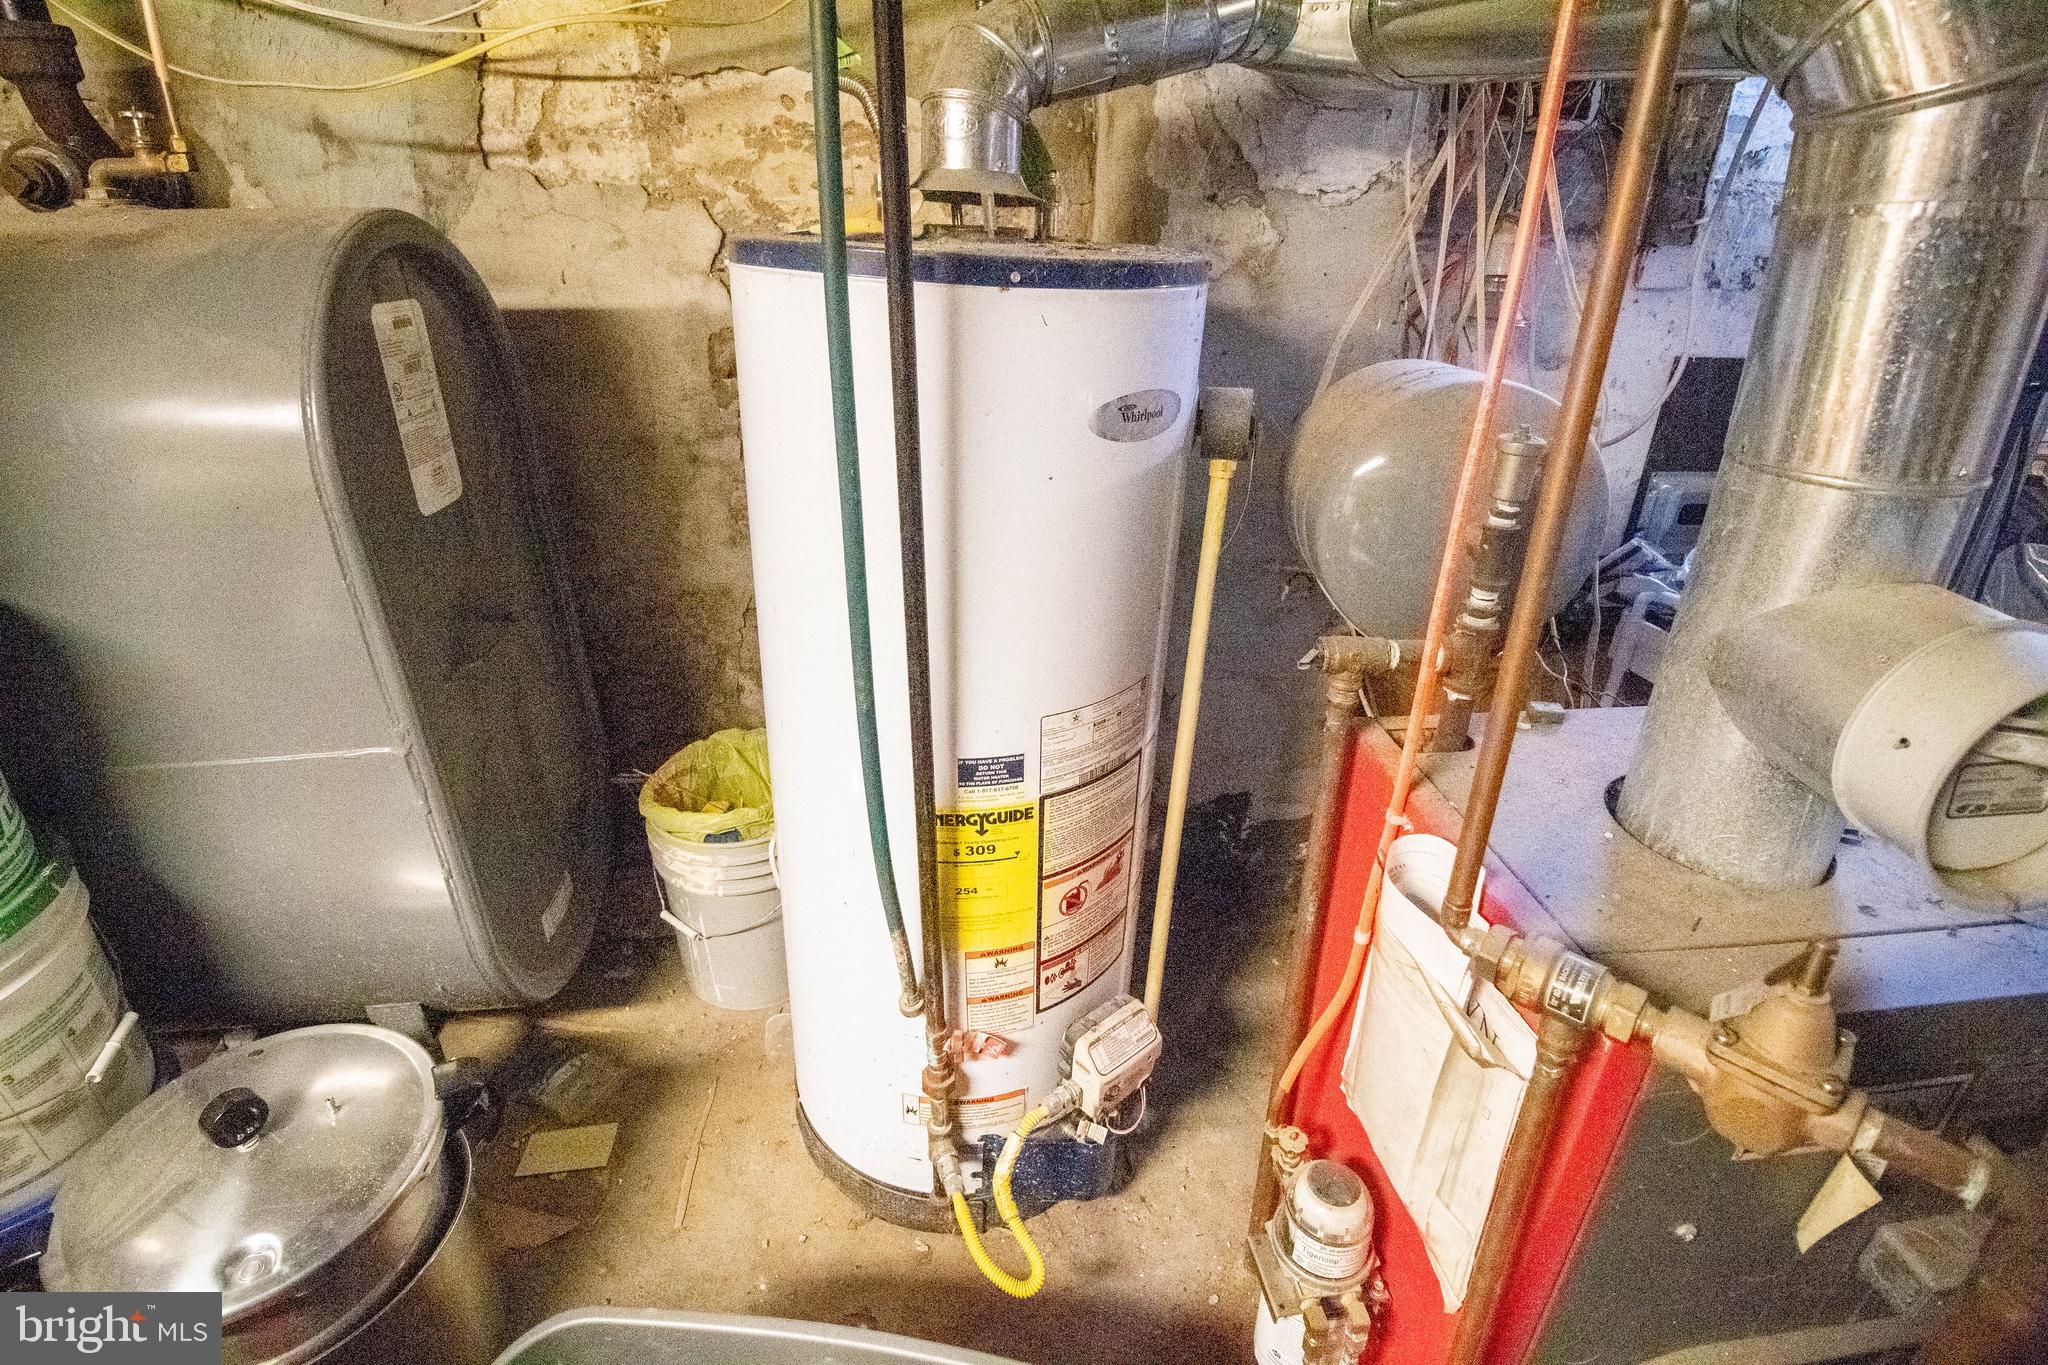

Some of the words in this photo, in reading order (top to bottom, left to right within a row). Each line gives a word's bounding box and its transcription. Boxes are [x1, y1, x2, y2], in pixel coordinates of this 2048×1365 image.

[1121, 405, 1164, 423] Whirlpool
[965, 844, 997, 856] 309
[955, 887, 978, 895] 254
[986, 946, 1024, 957] WARNING
[987, 990, 1024, 1002] WARNING
[960, 1097, 995, 1105] WARNING
